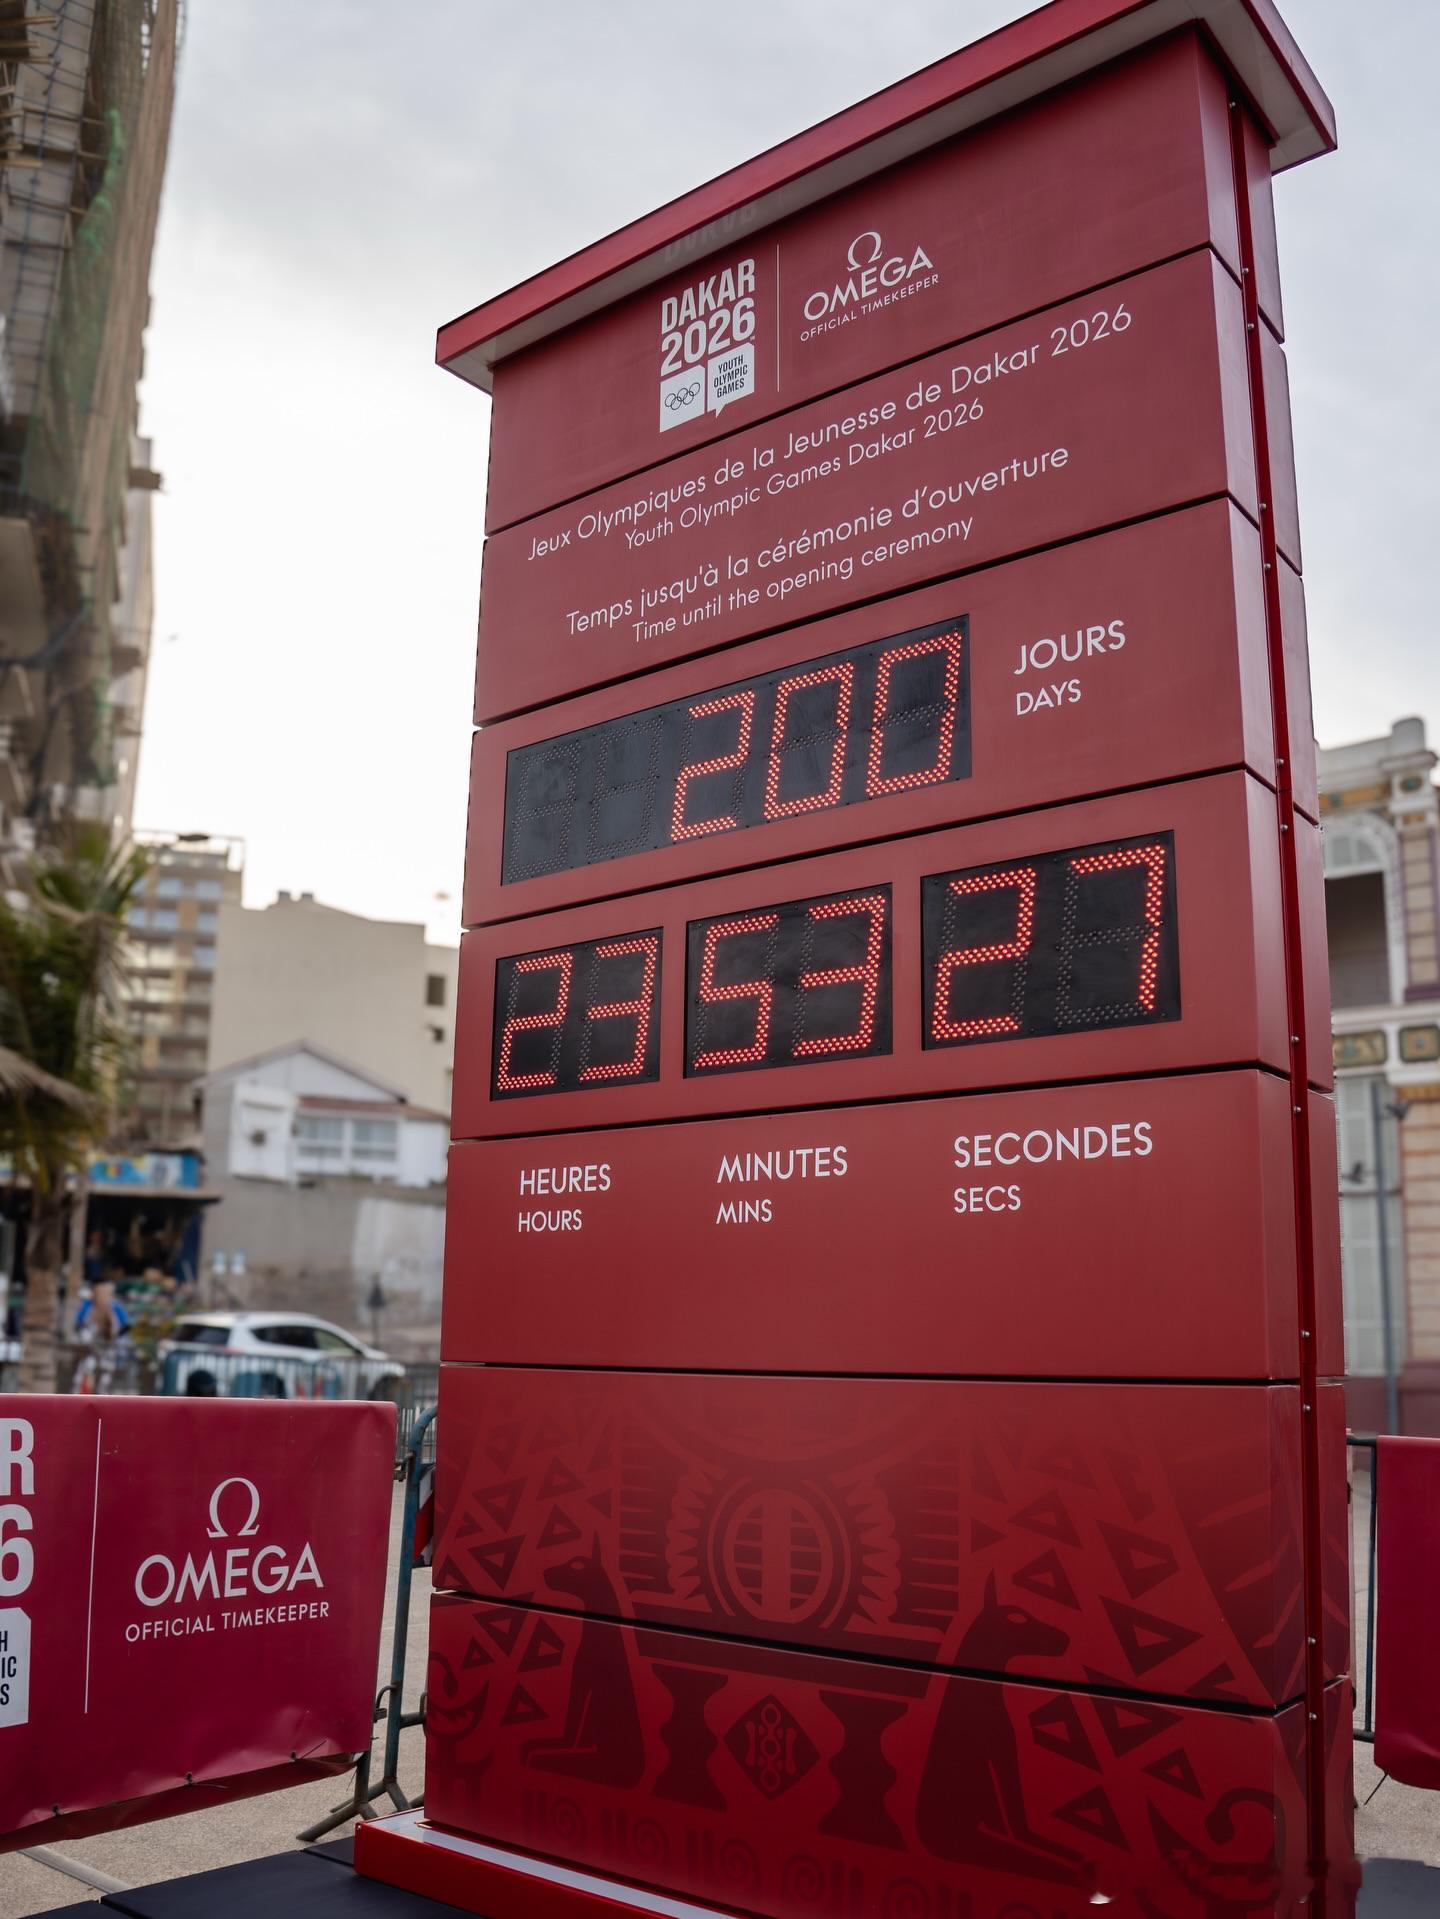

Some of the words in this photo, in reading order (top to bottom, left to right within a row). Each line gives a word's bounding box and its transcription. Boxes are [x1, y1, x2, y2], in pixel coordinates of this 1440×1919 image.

[661, 259, 756, 336] DAKAR
[800, 310, 858, 342] OFFICIAL
[861, 274, 939, 316] TIMEKEEPER
[803, 246, 934, 321] OMEGA
[660, 297, 756, 377] 2026
[718, 354, 744, 374] YOUTH
[713, 364, 748, 388] OLYMPIC
[717, 377, 745, 399] GAMES
[528, 530, 572, 560] Jeux
[577, 475, 707, 539] Olympiques
[714, 458, 745, 485] de
[753, 447, 775, 471] la
[784, 402, 897, 459] Jeunesse
[906, 382, 942, 411] de
[952, 344, 1041, 395] Dakar
[1050, 303, 1132, 357] 2026
[624, 516, 674, 550] Youth
[680, 486, 761, 529] Olympic
[767, 457, 841, 495] Games
[849, 428, 916, 466] Dakar
[923, 397, 984, 438] 2026
[566, 599, 633, 635] Temps
[640, 563, 719, 618] jusqu'à
[728, 555, 749, 580] la
[757, 507, 893, 569] cérémonie
[632, 616, 677, 643] Time
[683, 594, 722, 626] until
[728, 588, 761, 612] the
[767, 557, 854, 601] opening
[861, 517, 974, 567] ceremony
[1013, 620, 1127, 676] JOURS
[1015, 679, 1082, 716] DAYS
[671, 627, 963, 841] 200
[931, 844, 1168, 1042] 27
[497, 935, 659, 1091] 23
[693, 895, 887, 1071] 53
[716, 1145, 849, 1184] MINUTES
[953, 1121, 1154, 1169] SECONDES
[520, 1163, 612, 1196] HEURES
[715, 1199, 773, 1225] MINS
[953, 1185, 1022, 1214] SECS
[517, 1209, 583, 1233] HOURS
[134, 1541, 324, 1607] OMEGA
[124, 1615, 216, 1643] OFFICIAL
[221, 1601, 330, 1630] TIMEKEEPER
